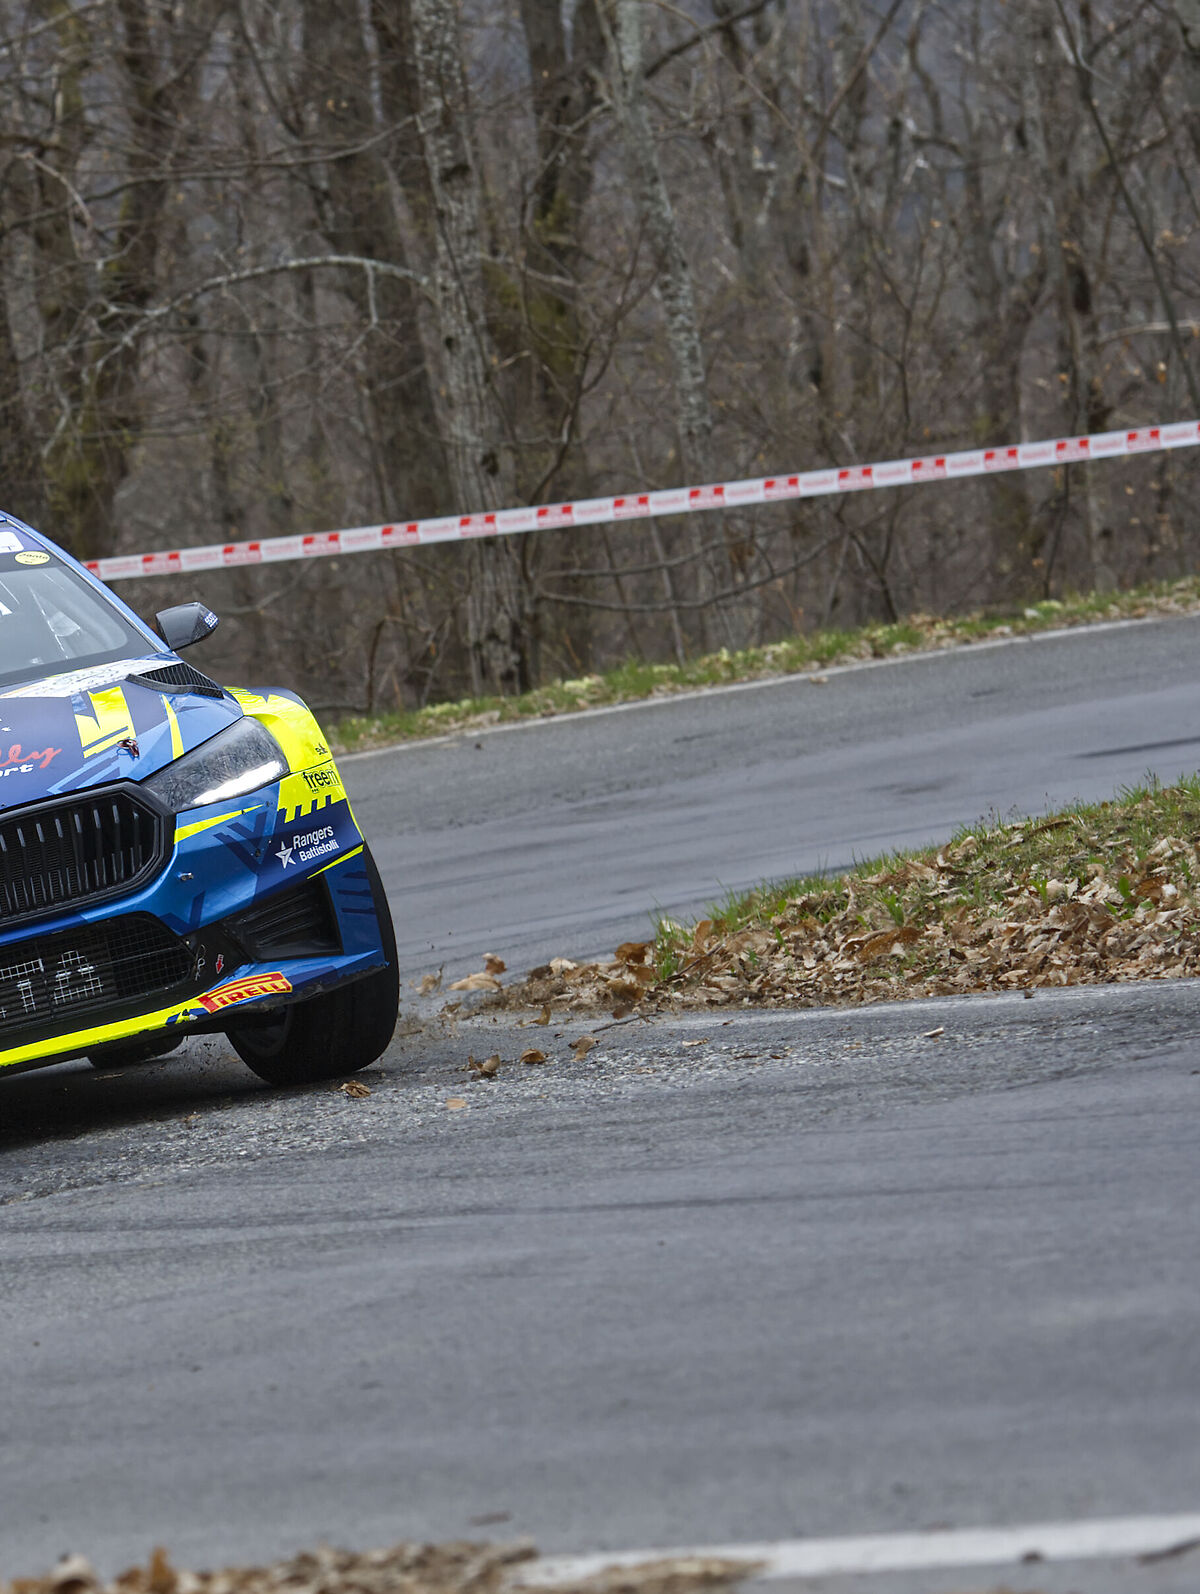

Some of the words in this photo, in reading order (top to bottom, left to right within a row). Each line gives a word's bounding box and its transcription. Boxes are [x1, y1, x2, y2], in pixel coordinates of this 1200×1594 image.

[302, 770, 340, 789] freem
[292, 825, 334, 849] Rangers
[299, 839, 340, 863] Battistolli
[197, 972, 291, 1013] PIRELLI
